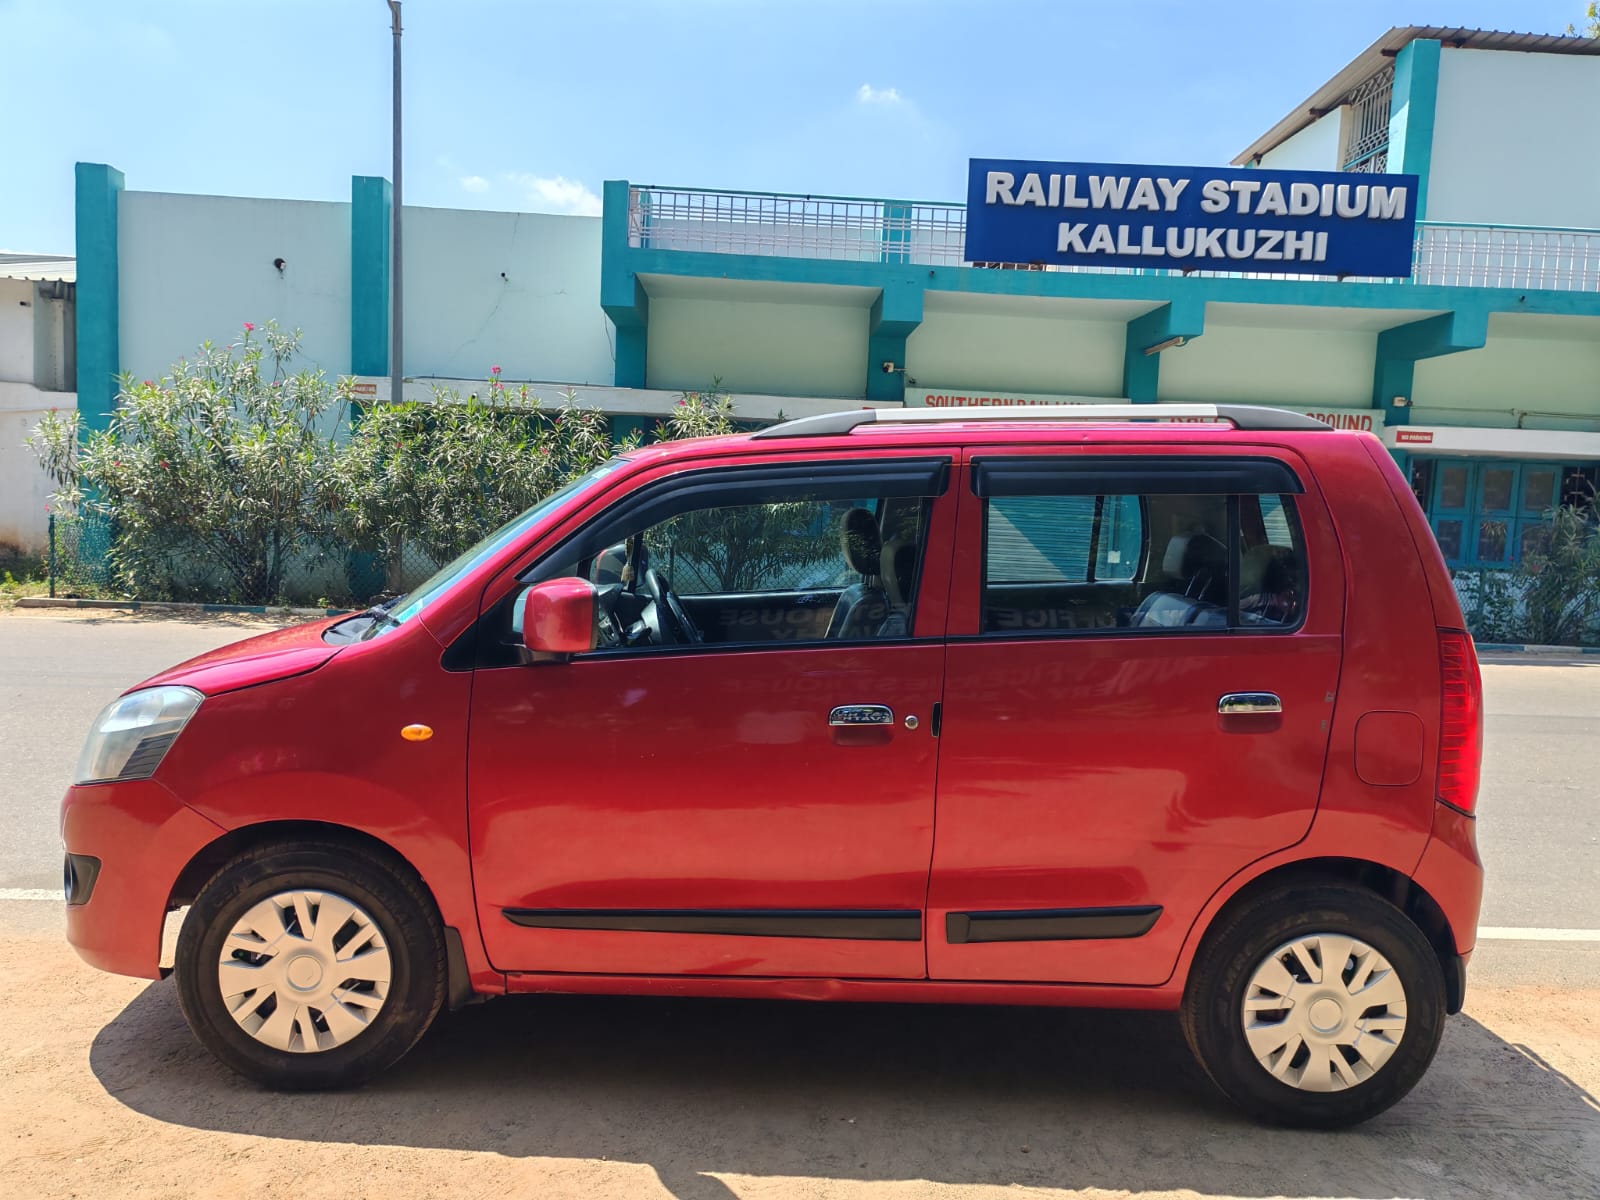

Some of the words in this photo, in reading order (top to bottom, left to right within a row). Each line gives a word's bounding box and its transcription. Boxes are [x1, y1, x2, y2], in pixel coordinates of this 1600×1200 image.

[985, 171, 1191, 213] RAILWAY
[1200, 179, 1408, 220] STADIUM
[1057, 222, 1329, 262] KALLUKUZHI
[1306, 412, 1373, 432] OUND
